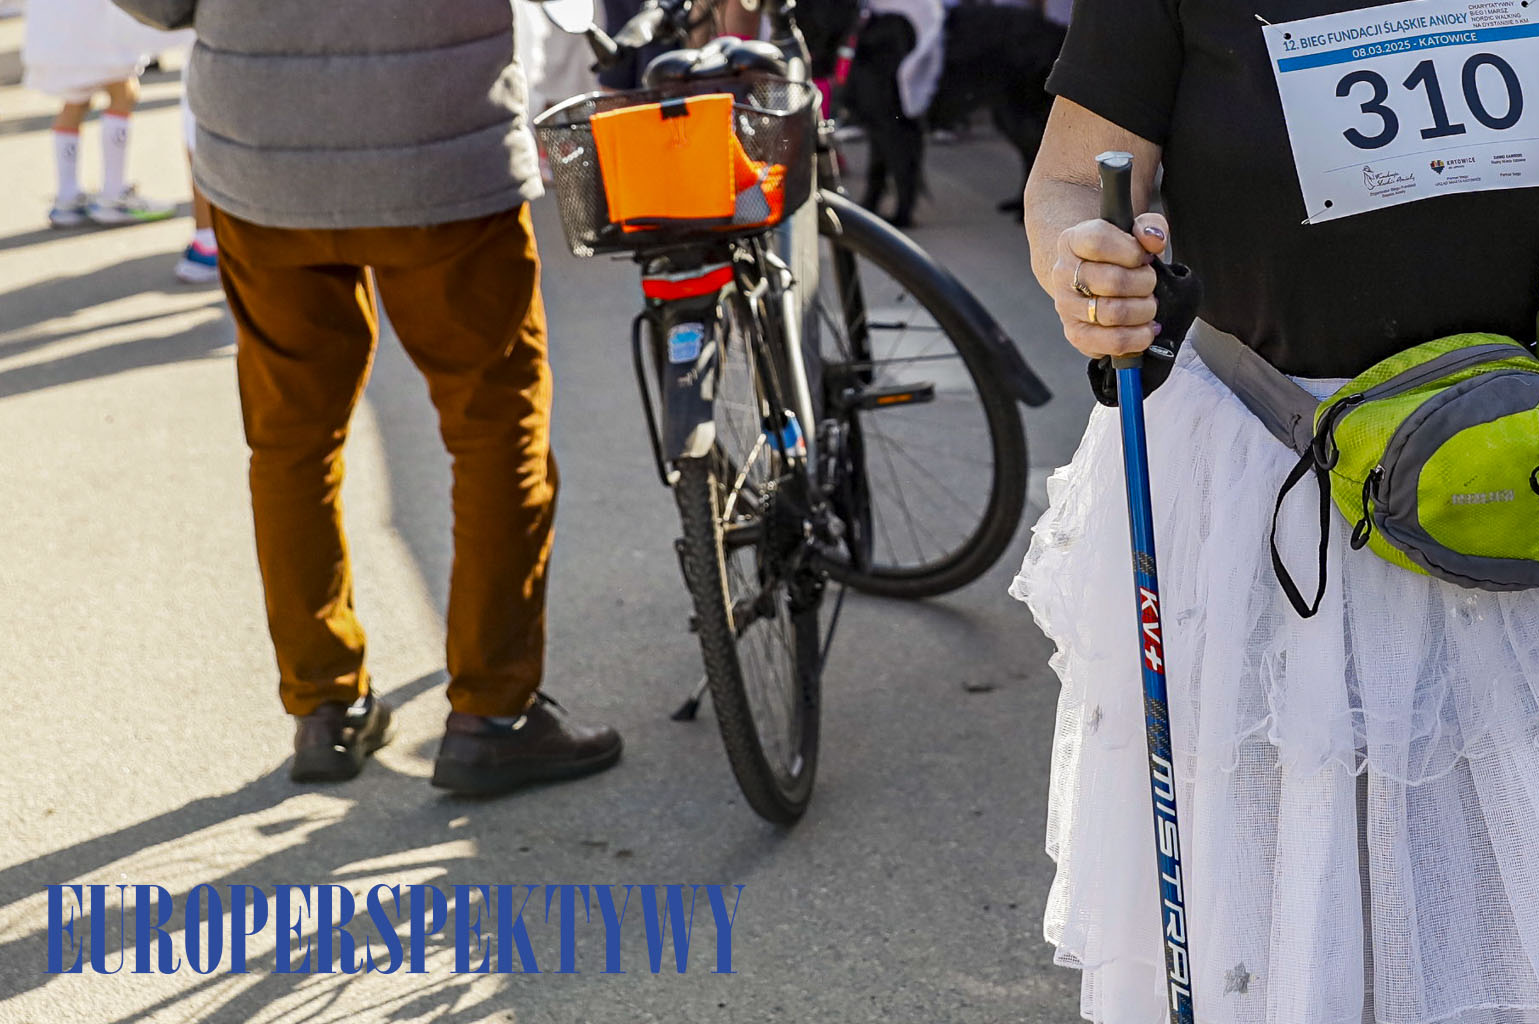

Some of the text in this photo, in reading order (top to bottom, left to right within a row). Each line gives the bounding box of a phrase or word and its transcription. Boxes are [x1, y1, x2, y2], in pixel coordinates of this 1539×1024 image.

[1488, 7, 1509, 15] MARSZ
[1283, 12, 1468, 52] 12. BIEG FUNDACJI ŚLĄSKIE ANIOŁY
[1352, 39, 1411, 59] 08.03.2025
[1418, 32, 1478, 48] KATOWICE
[1335, 52, 1524, 150] 310
[1151, 752, 1191, 1011] MISTRAL
